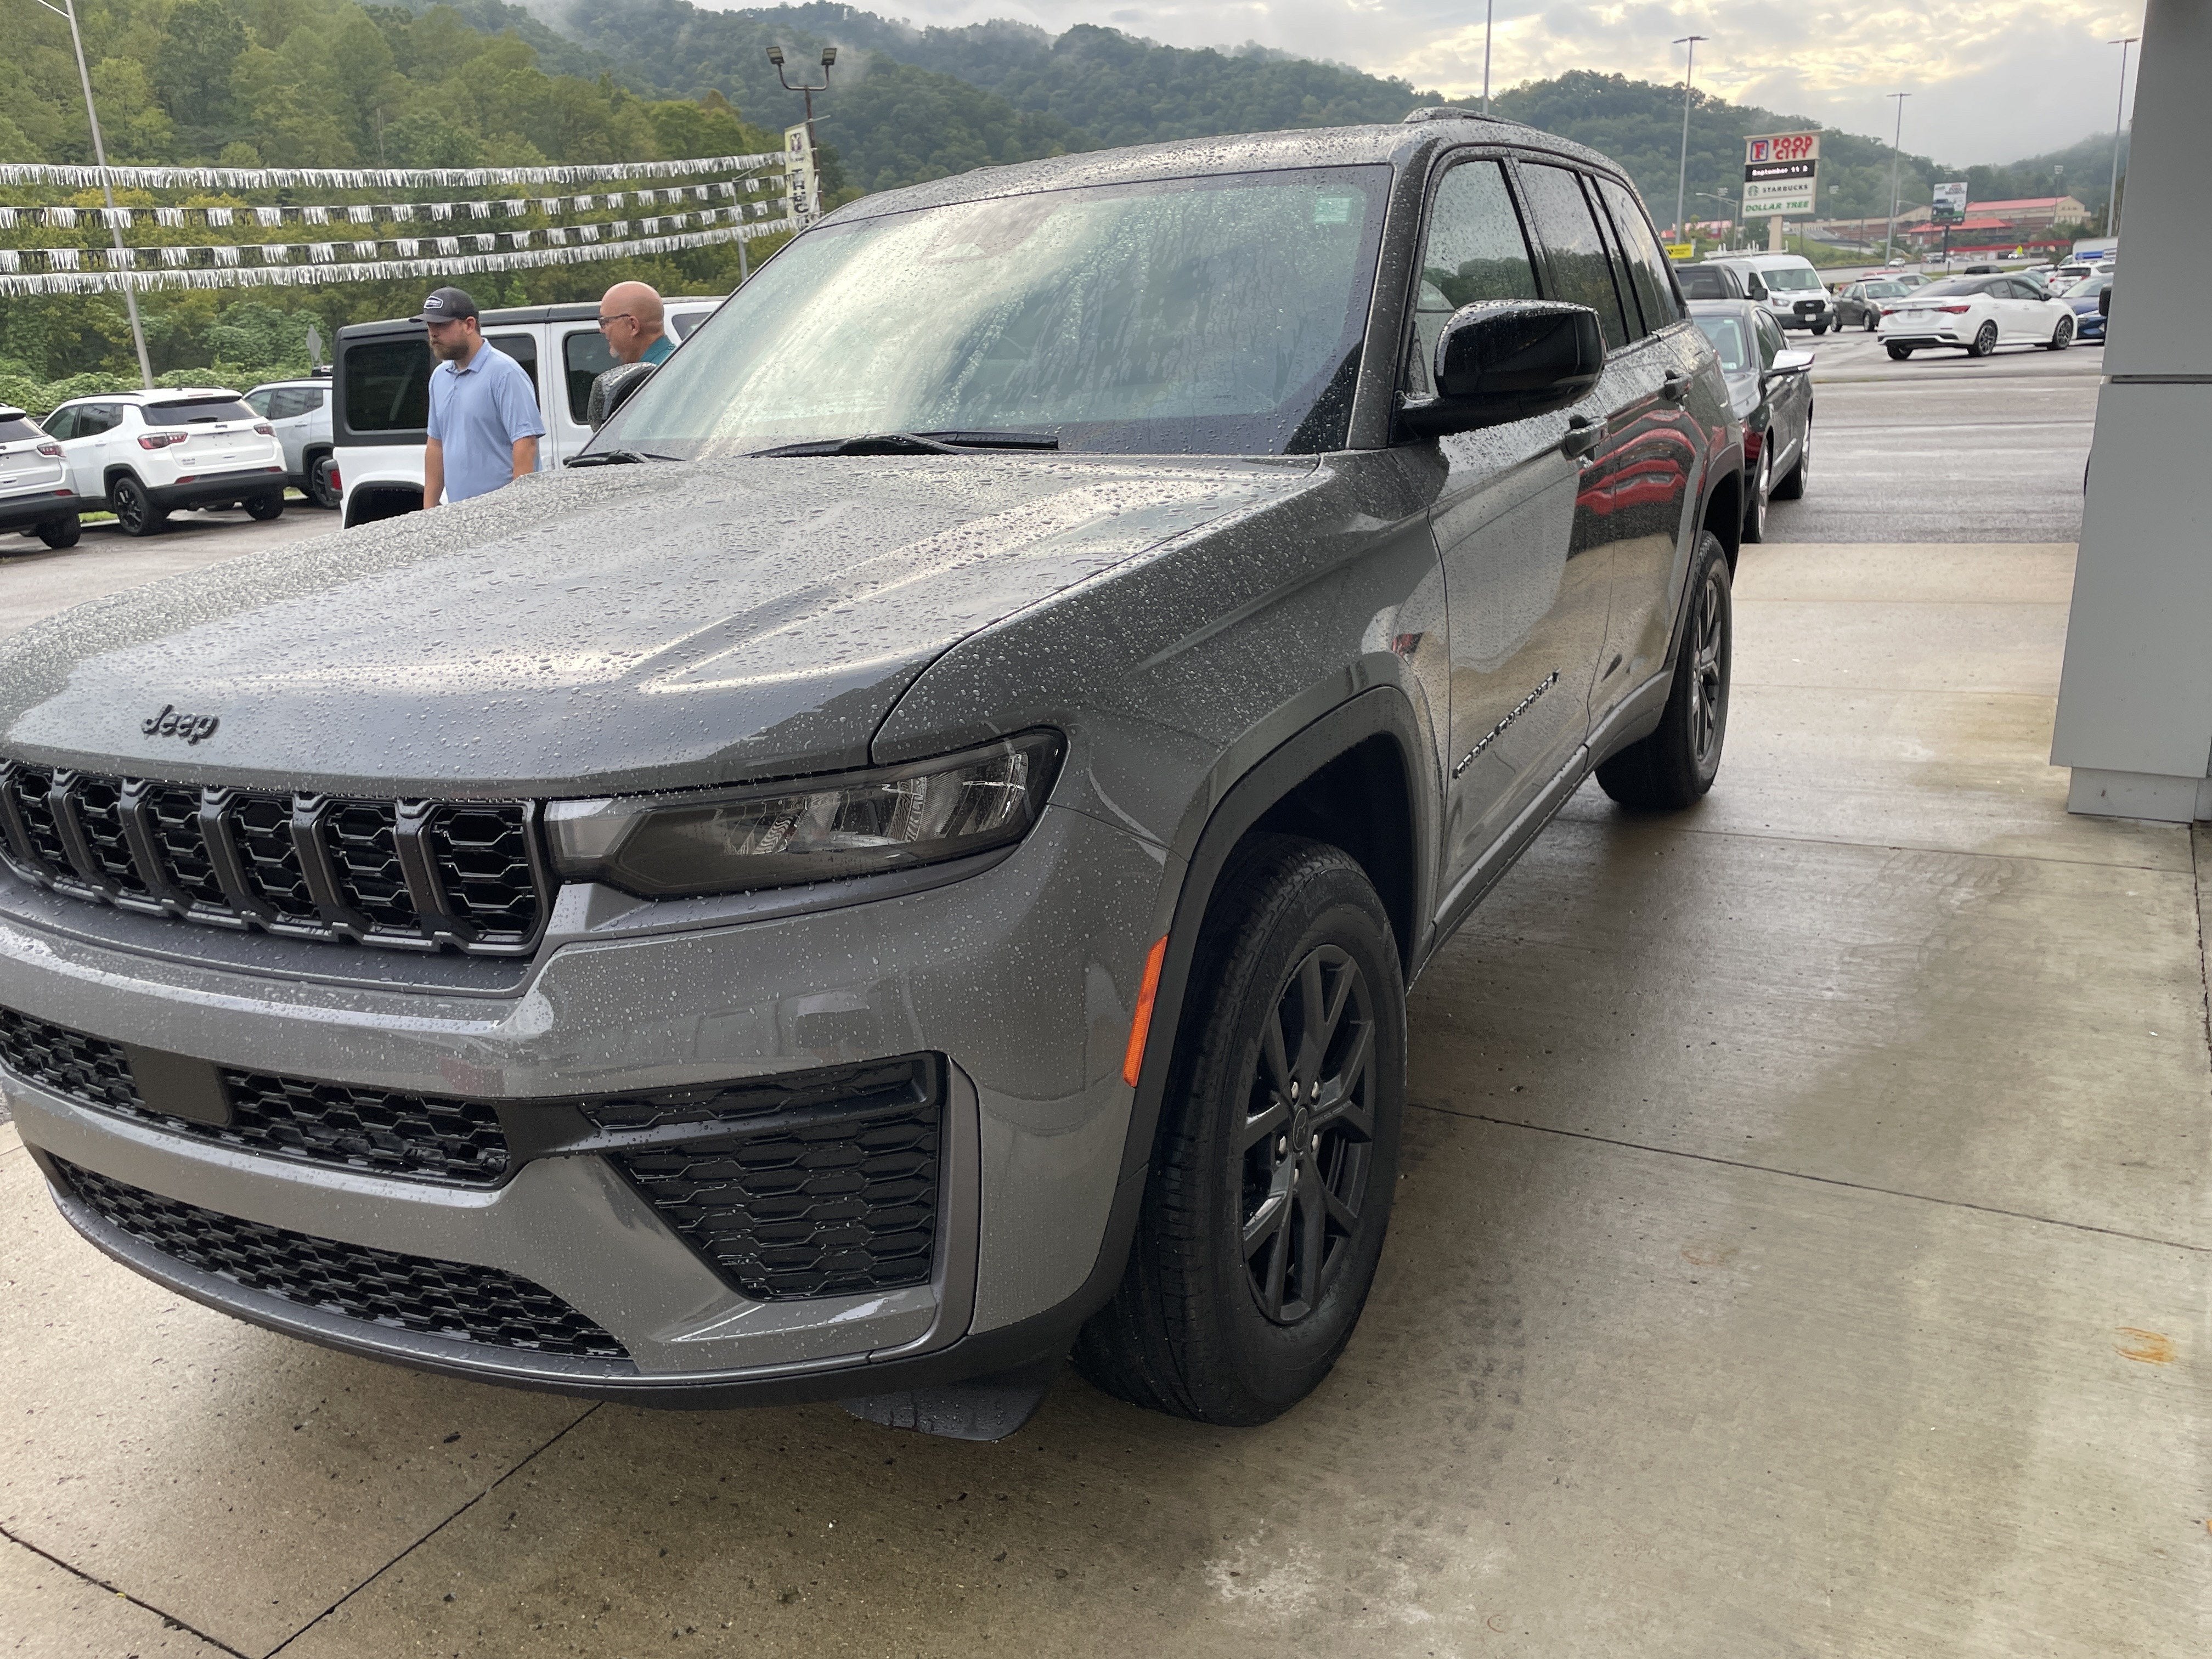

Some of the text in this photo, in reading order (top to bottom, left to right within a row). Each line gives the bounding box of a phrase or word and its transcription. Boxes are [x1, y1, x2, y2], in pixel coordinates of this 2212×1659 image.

[1773, 137, 1812, 150] FOOD
[1776, 148, 1808, 159] CITY
[1746, 203, 1782, 211] DOLLAR
[142, 704, 219, 746] Jeep
